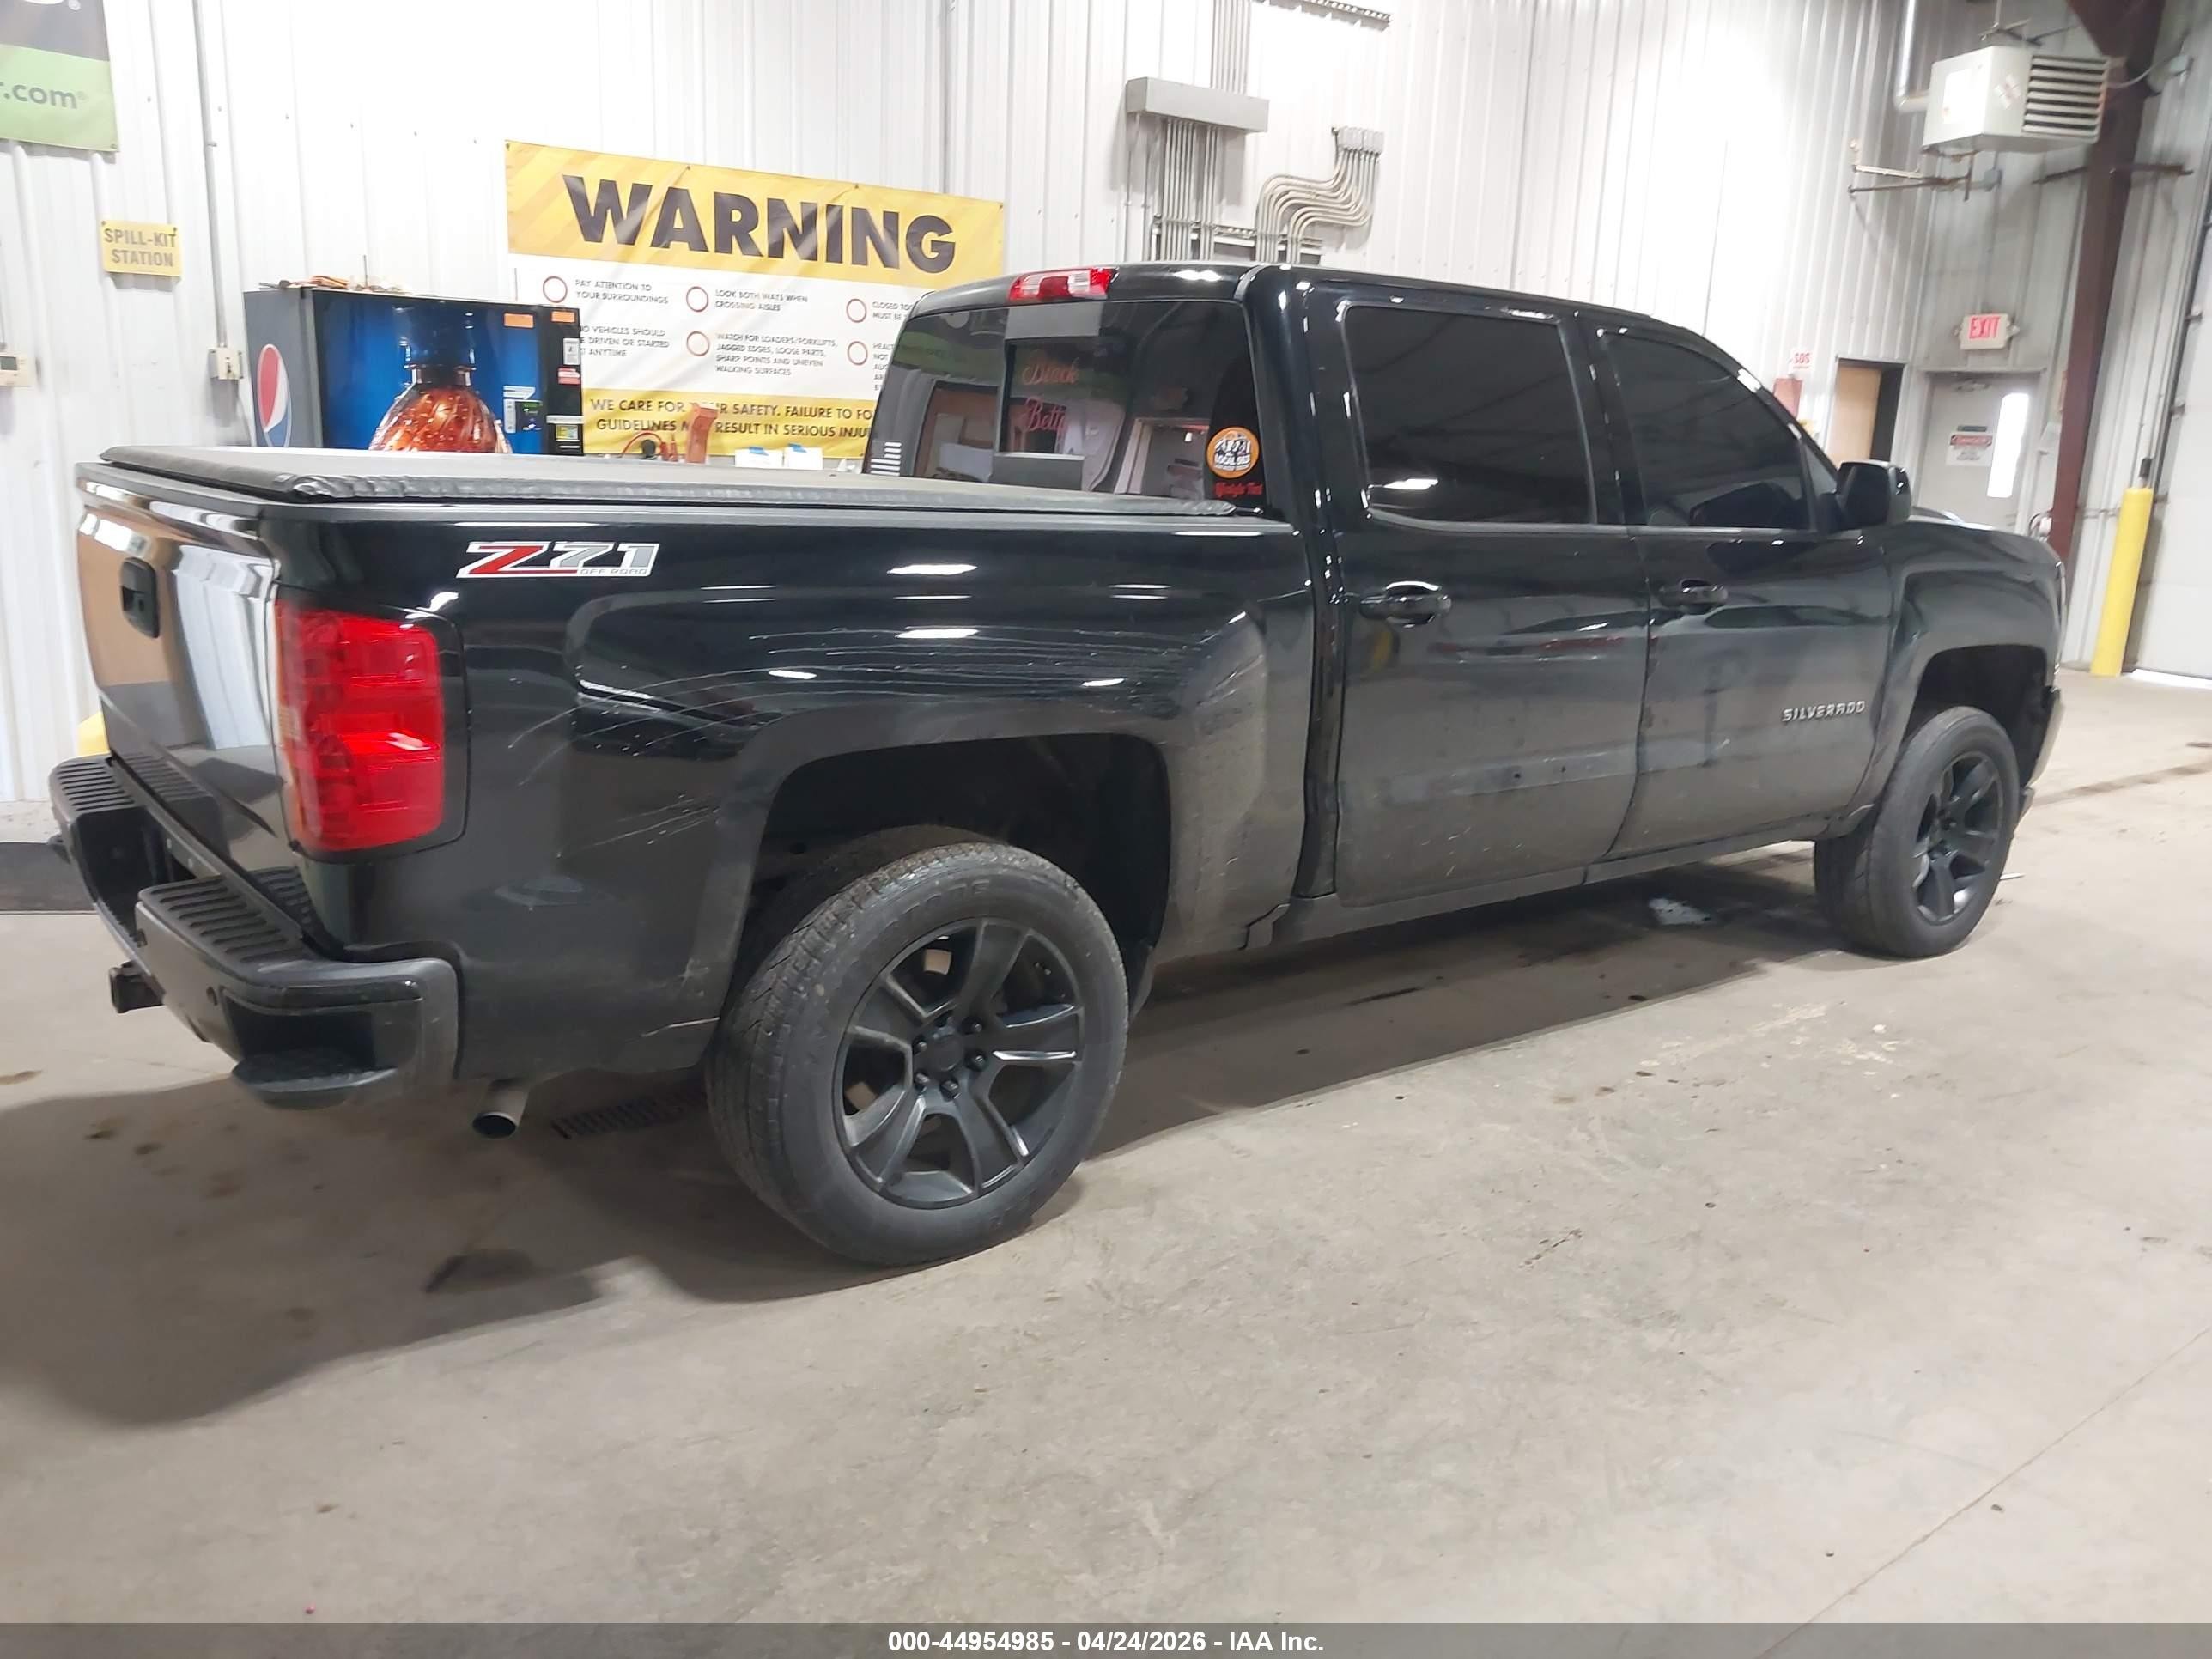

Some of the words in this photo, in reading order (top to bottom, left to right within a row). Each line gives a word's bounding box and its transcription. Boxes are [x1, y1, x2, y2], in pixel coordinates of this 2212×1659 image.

[562, 174, 956, 274] WARNING
[104, 228, 176, 247] SPILL-KIT
[111, 249, 173, 267] STATION
[595, 281, 638, 290] ATTENTION
[602, 292, 669, 304] SURROUNDINGS
[715, 301, 755, 309] CROSSING
[633, 328, 665, 337] SHOULD
[1969, 316, 2002, 339] EXIT
[715, 364, 753, 374] WALKING
[755, 367, 792, 375] SURFACES
[744, 356, 771, 364] POINTS
[793, 358, 823, 367] UNEVEN
[590, 398, 616, 410] WE
[619, 399, 653, 411] CARE
[658, 401, 685, 412] FOR
[732, 403, 781, 417] SAFETY.
[785, 405, 832, 418] FAILURE
[836, 408, 852, 419] TO
[596, 418, 677, 431] GUIDELINES
[714, 422, 762, 434] RESULT
[763, 423, 779, 434] IN
[783, 424, 836, 438] SERIOUS
[838, 427, 868, 438] INJU
[455, 541, 660, 578] Z71
[1782, 700, 1865, 722] SILVERADO
